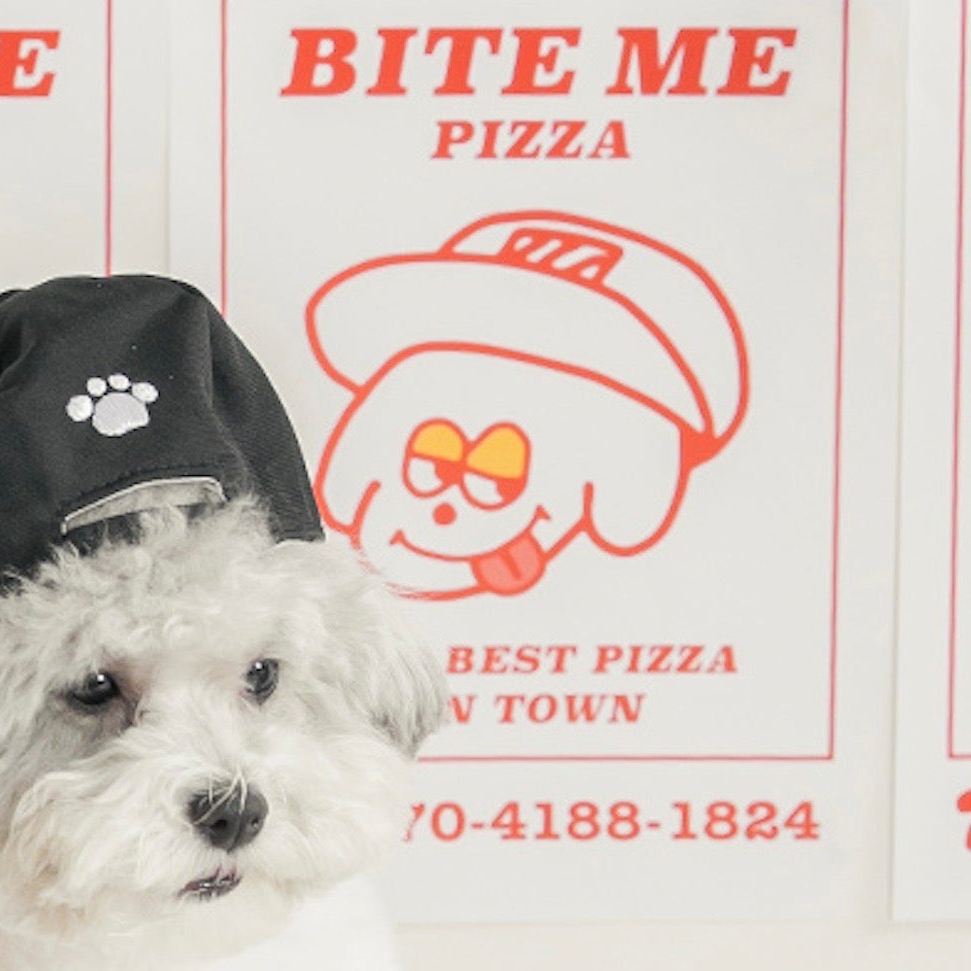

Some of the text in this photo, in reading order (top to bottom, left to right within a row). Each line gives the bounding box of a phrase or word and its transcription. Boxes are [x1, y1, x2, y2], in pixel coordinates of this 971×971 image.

[281, 28, 796, 96] BITE ME
[433, 121, 629, 159] PIZZA
[447, 646, 735, 673] BEST PIZZA
[498, 695, 642, 723] TOWN
